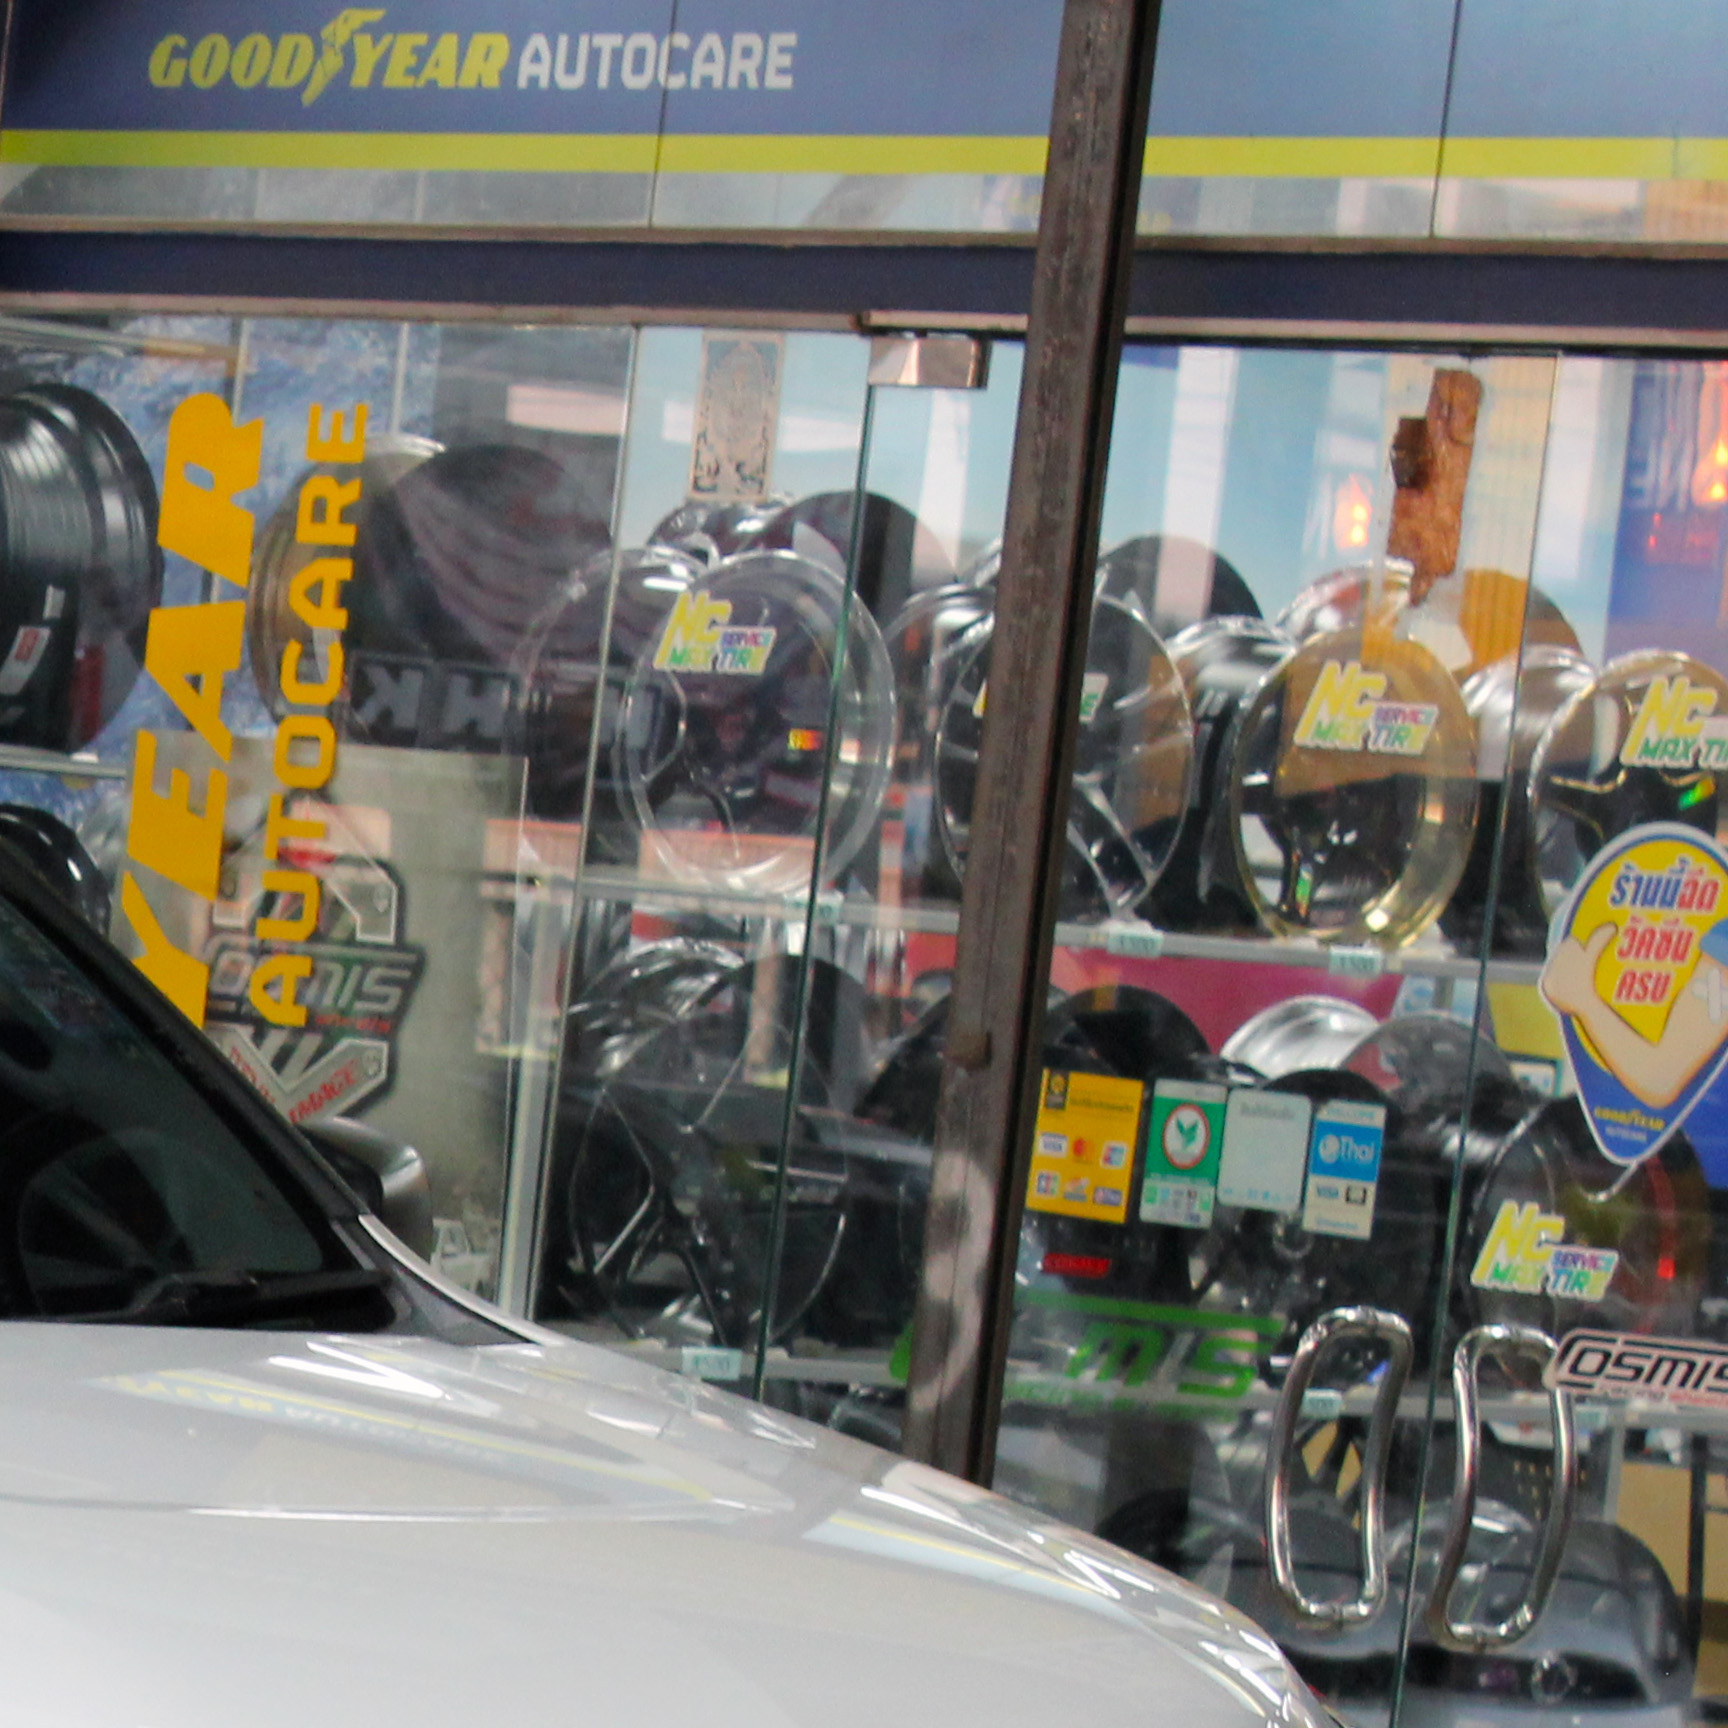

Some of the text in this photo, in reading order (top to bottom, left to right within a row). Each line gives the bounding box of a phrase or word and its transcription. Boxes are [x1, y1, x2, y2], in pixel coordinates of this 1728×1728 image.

[147, 31, 798, 90] GOODYEAR AUTOCARE
[656, 592, 732, 664] NC
[249, 402, 370, 1028] AUTOCARE
[1299, 664, 1386, 738] NC
[1625, 679, 1716, 758] NC
[1639, 738, 1696, 761] MAX
[1615, 968, 1672, 1004] ครบ
[1474, 1203, 1565, 1281] NC
